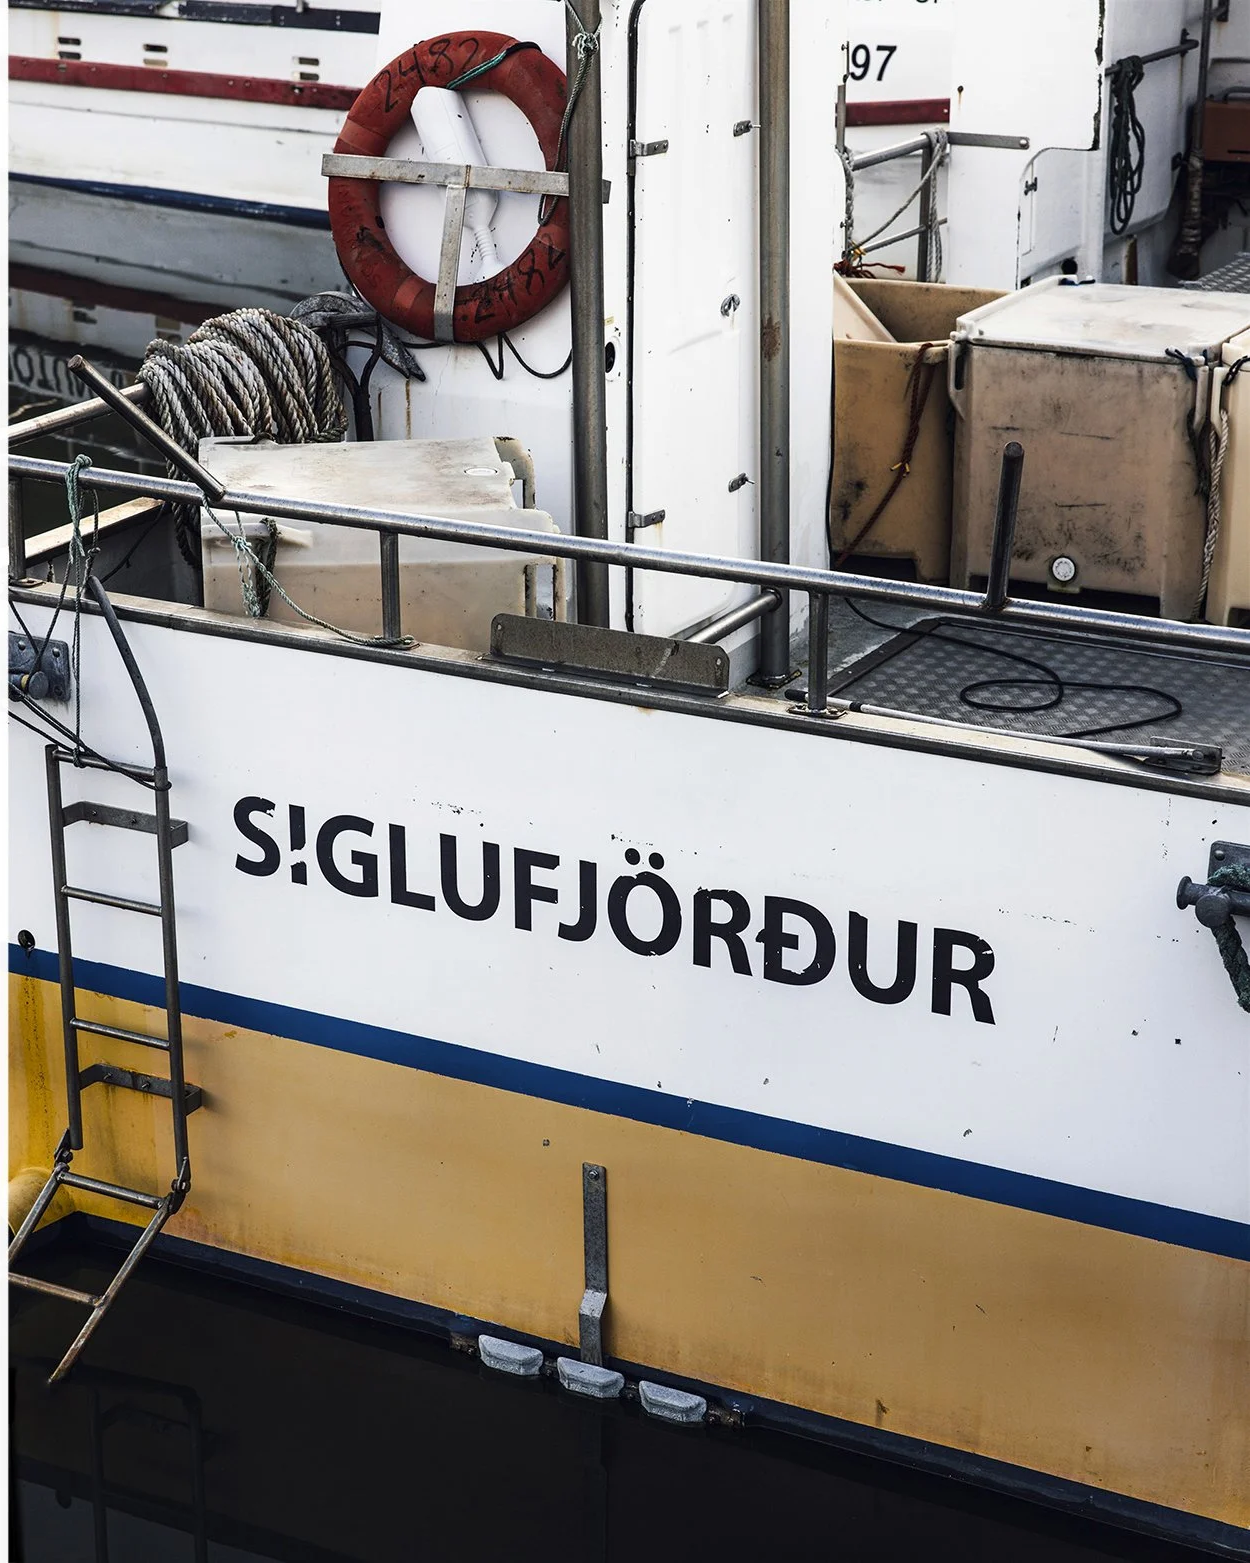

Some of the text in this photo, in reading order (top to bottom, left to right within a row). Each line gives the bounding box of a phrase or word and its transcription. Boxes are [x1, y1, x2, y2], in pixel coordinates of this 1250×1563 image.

[374, 37, 480, 113] 2482
[850, 43, 898, 82] 97
[232, 795, 997, 1026] SIGLUFJÖRÐUR
